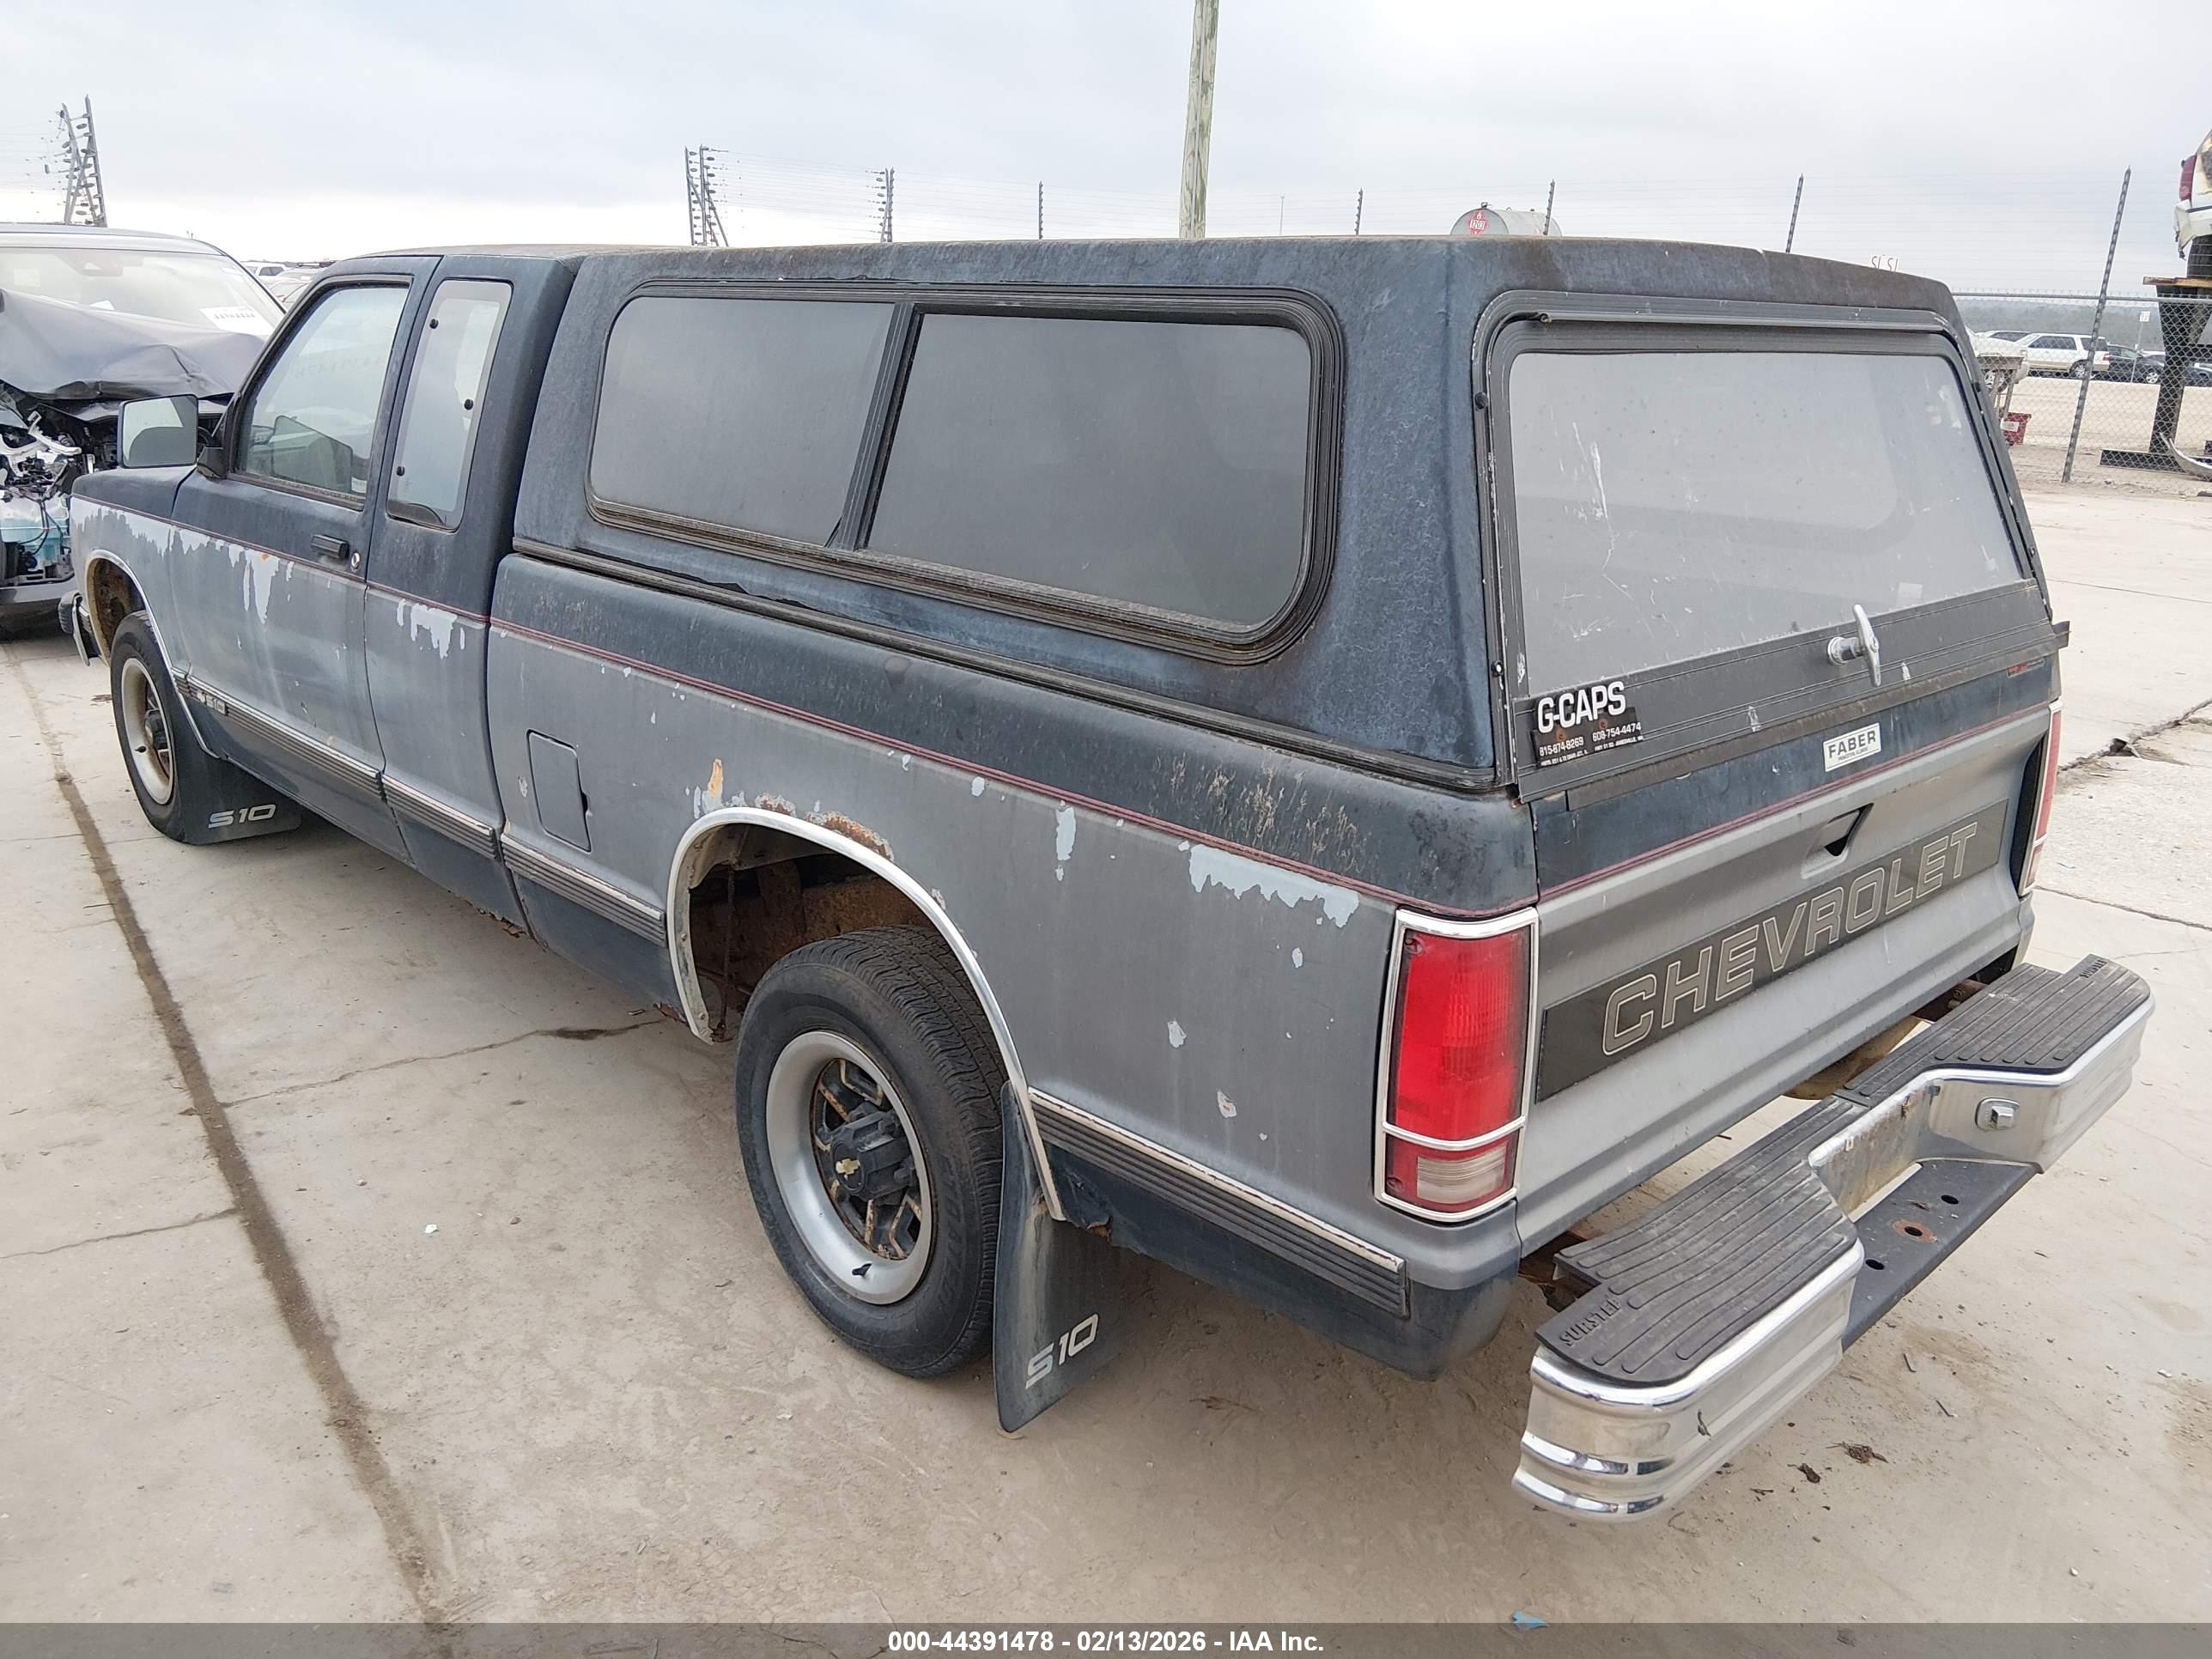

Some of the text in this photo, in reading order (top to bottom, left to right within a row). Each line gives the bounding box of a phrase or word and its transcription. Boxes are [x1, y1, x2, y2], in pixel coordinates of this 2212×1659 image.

[1470, 220, 1485, 229] 1203
[1538, 681, 1626, 733] G-CAPS
[1592, 722, 1641, 741] 608-754-4474
[1828, 730, 1876, 758] FABER
[1539, 737, 1584, 757] 815-874-8269
[208, 804, 276, 829] S10
[1602, 821, 1978, 1056] CHEVROLET
[1025, 1314, 1099, 1390] S10
